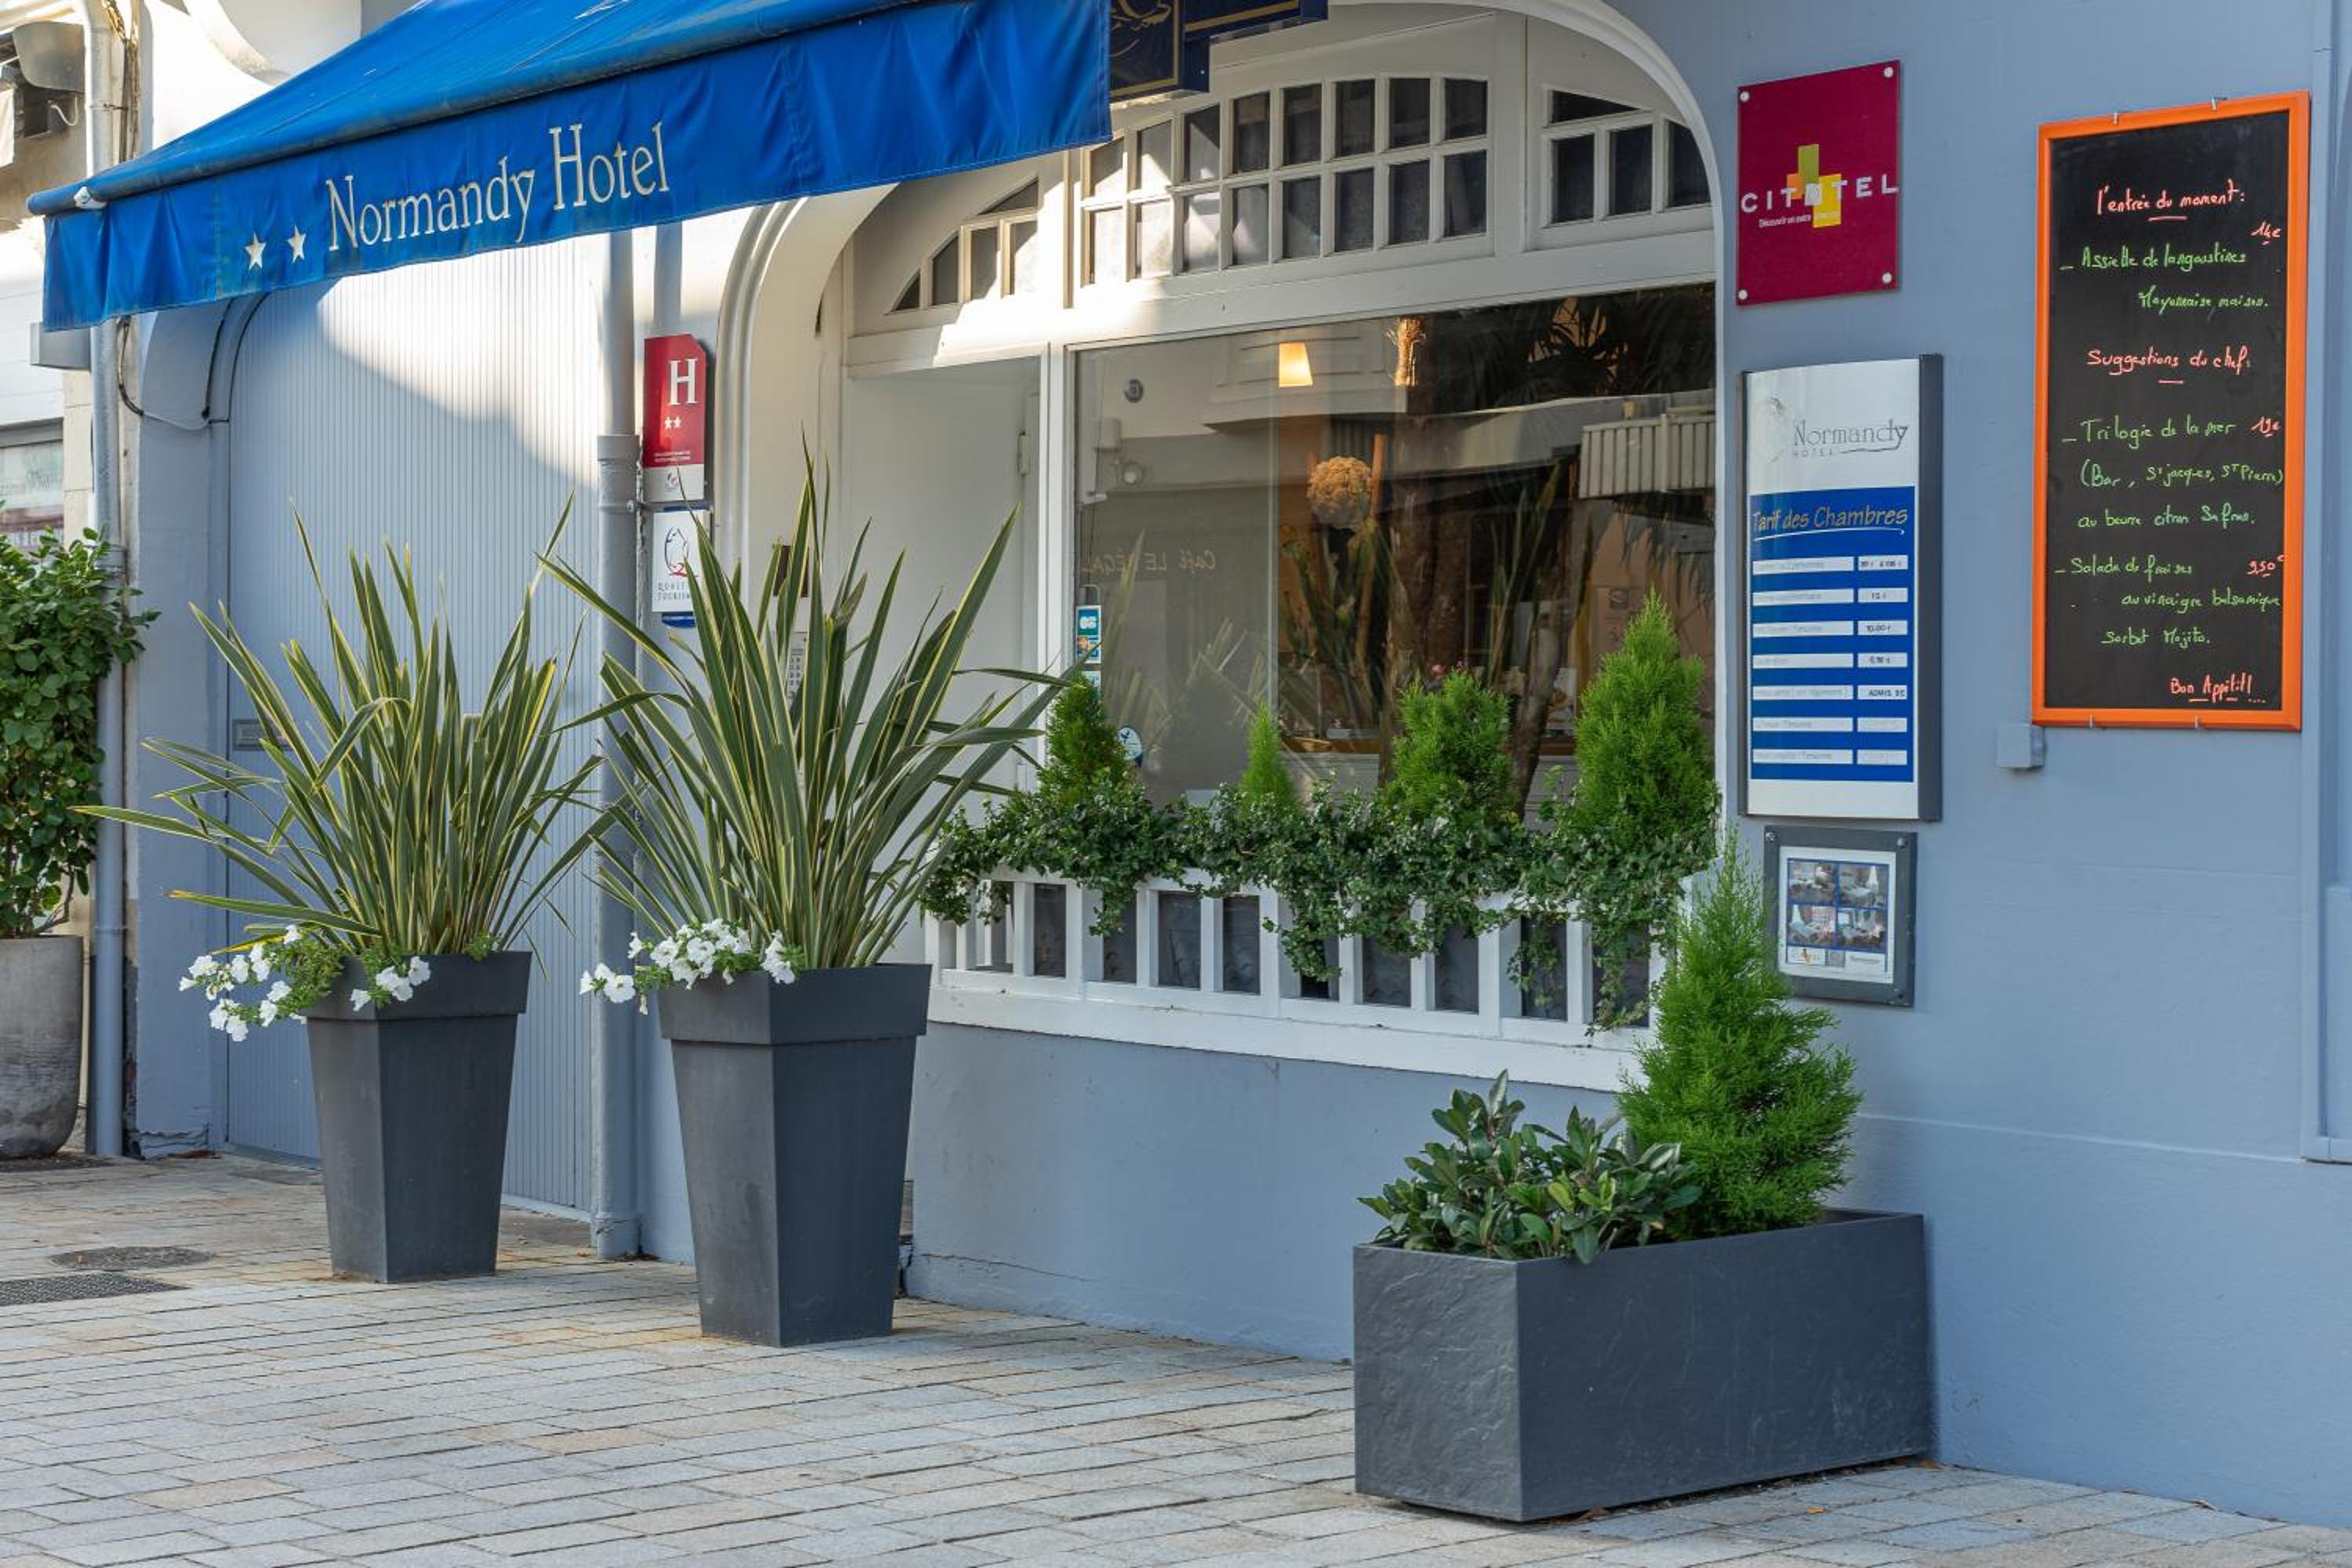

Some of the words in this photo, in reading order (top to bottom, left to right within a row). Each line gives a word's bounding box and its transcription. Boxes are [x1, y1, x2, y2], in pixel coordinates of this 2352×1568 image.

[326, 157, 535, 252] Normandy
[549, 122, 670, 210] Hotel
[2156, 190, 2172, 210] du
[2082, 245, 2138, 267] Assiette
[2142, 248, 2158, 267] de
[2163, 242, 2247, 271] langoustines
[2087, 347, 2179, 375] Suggestions
[2190, 350, 2207, 366] du
[669, 358, 699, 406] H
[1794, 418, 1909, 451] Normandy
[2080, 415, 2152, 449] Trilogie
[2161, 418, 2177, 437] de
[2205, 423, 2236, 437] mer
[1752, 510, 1782, 532] Tarif
[1782, 509, 1809, 528] des
[1813, 504, 1907, 528] Chambres
[2071, 554, 2121, 575] Salade
[2125, 556, 2140, 573] de
[2144, 592, 2202, 614] vinaigre
[2212, 586, 2281, 612] balsamique
[2100, 626, 2150, 646] Sorbet
[2170, 677, 2194, 694] Bon
